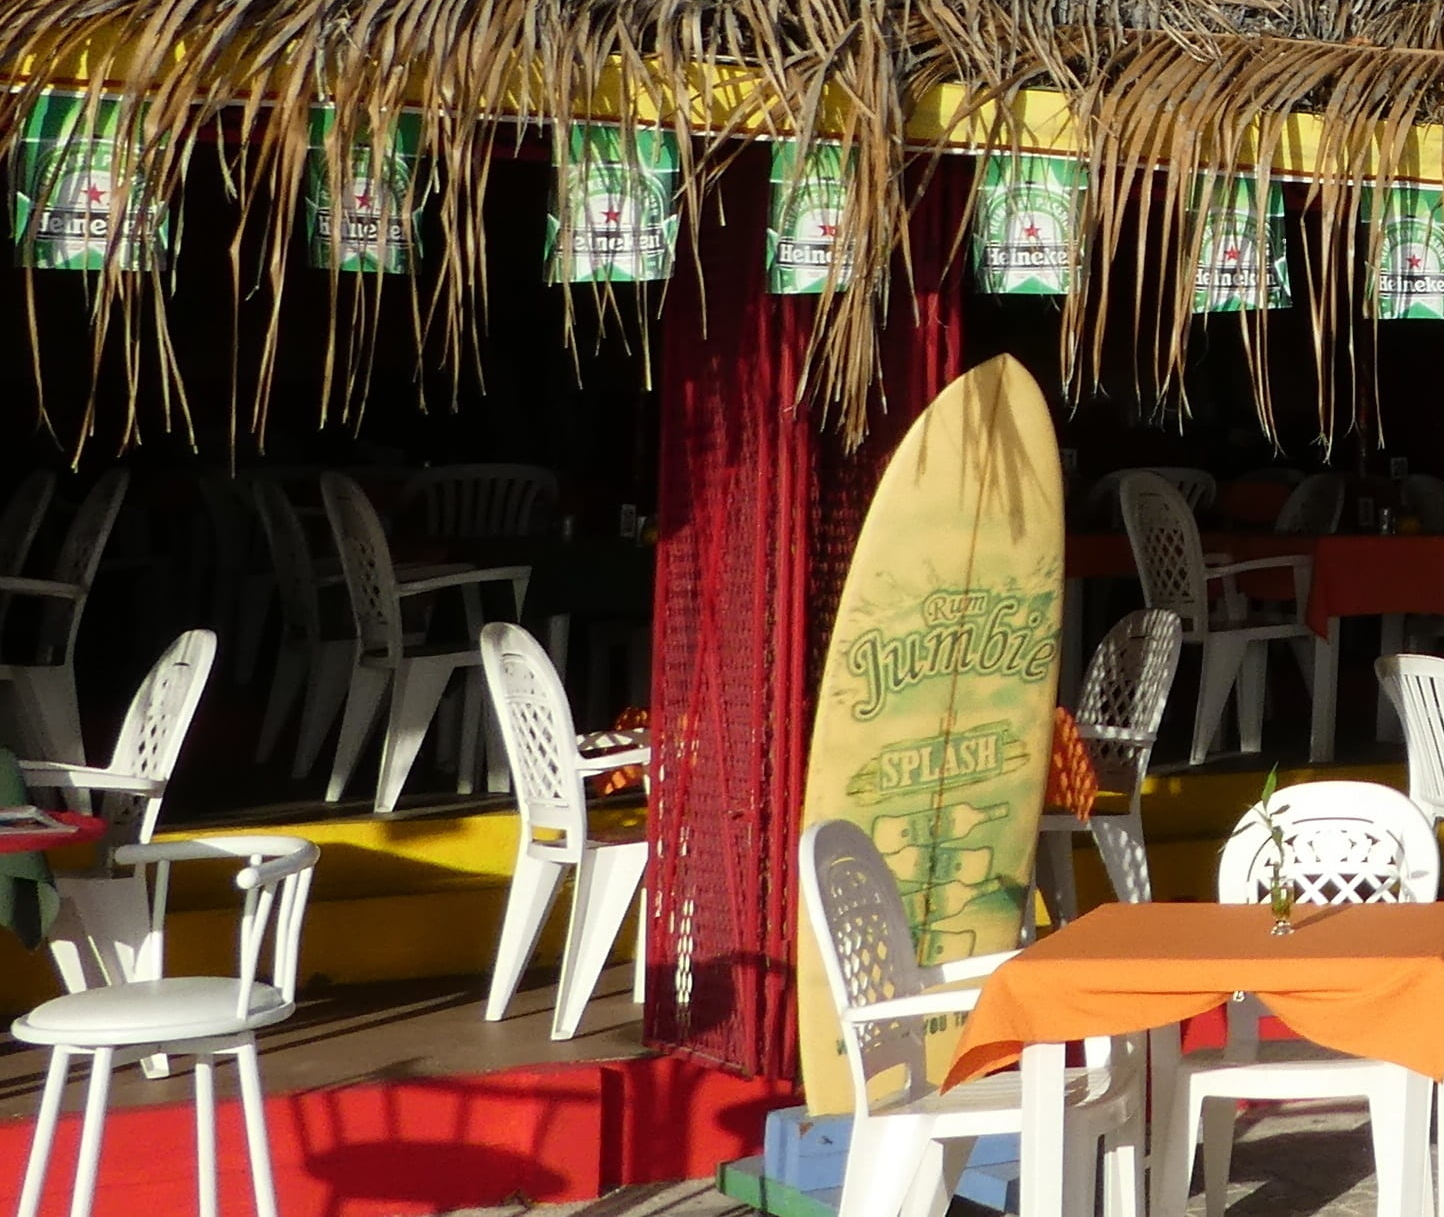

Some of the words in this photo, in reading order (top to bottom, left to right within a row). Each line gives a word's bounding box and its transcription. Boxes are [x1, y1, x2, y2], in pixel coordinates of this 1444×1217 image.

[986, 247, 1070, 266] Heineke
[926, 592, 987, 623] Rum
[852, 597, 1057, 719] Jumbie
[880, 735, 998, 788] SPLASH
